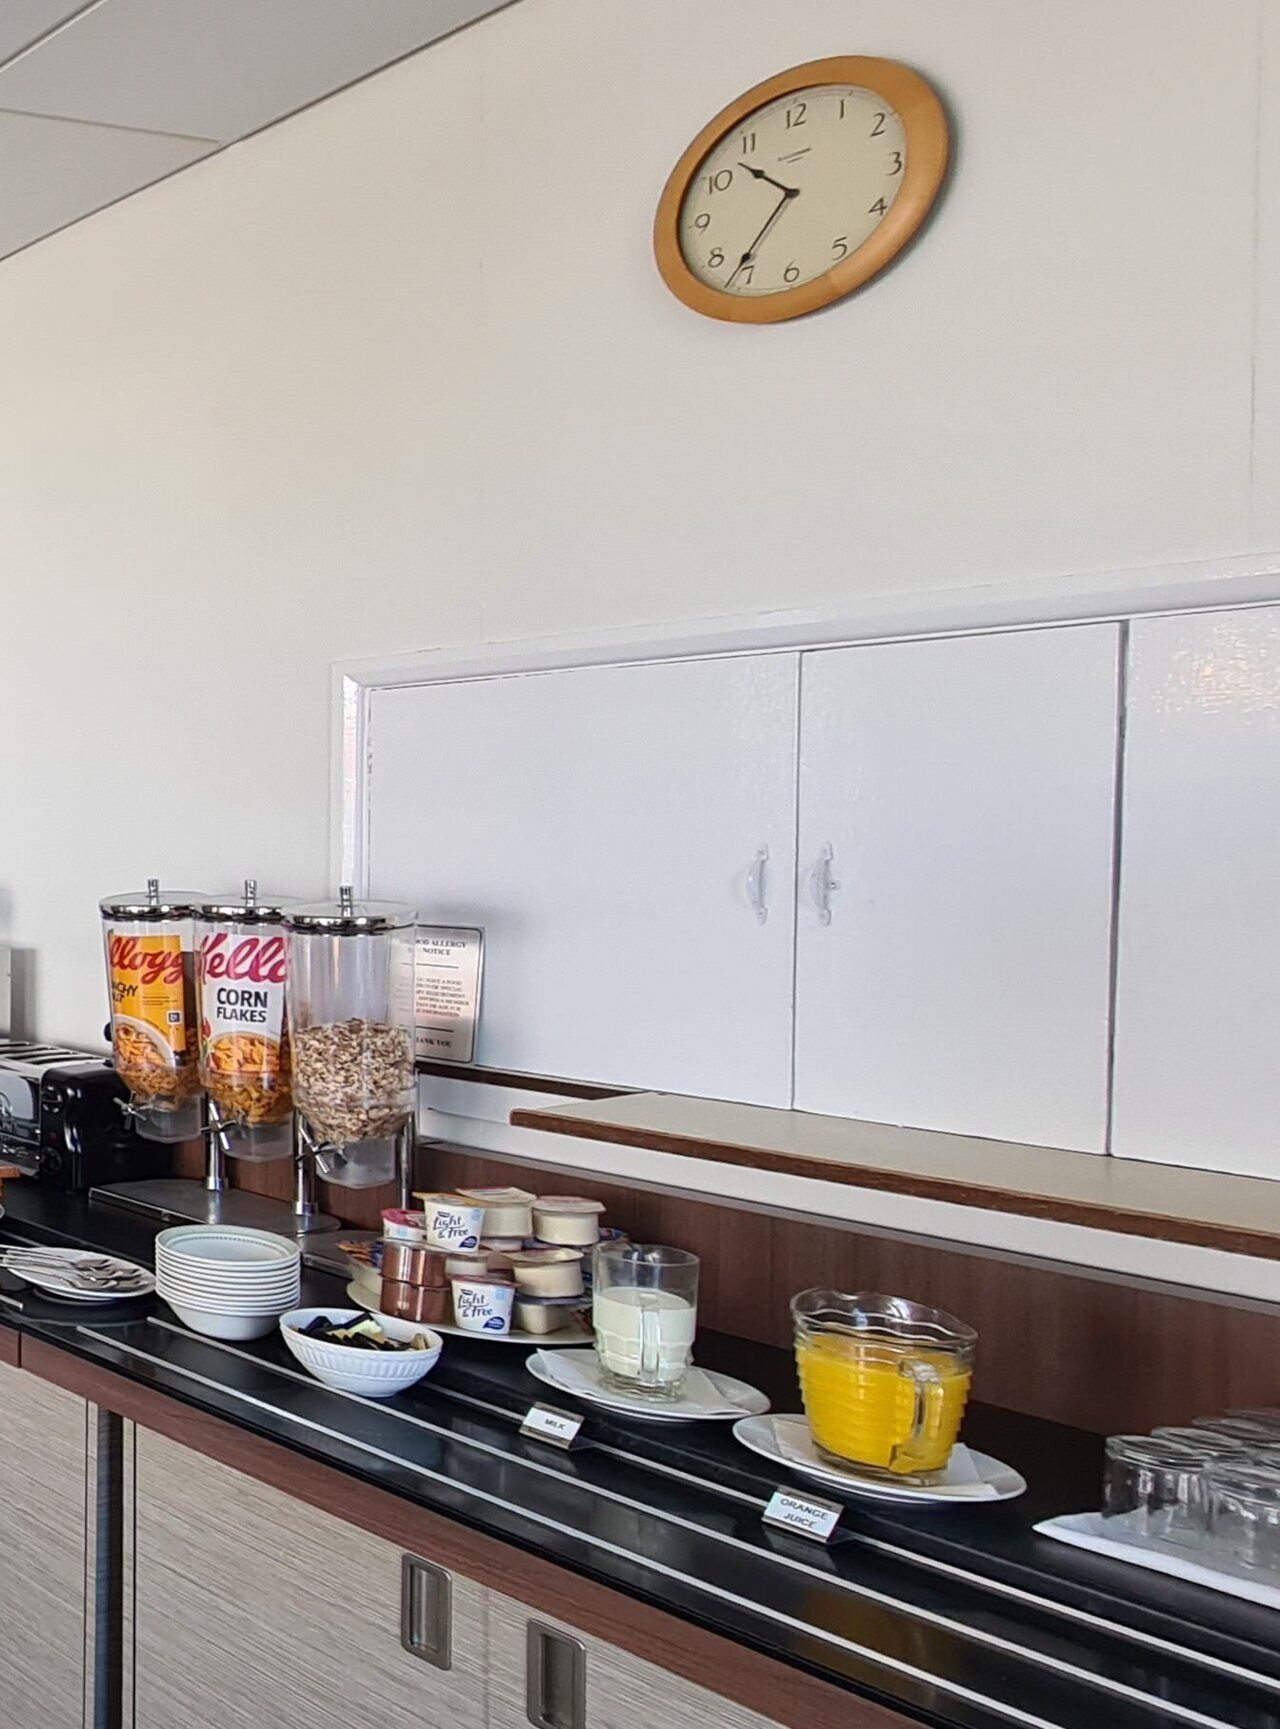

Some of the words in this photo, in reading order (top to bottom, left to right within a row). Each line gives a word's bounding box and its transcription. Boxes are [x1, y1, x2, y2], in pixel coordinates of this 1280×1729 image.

[785, 102, 807, 129] 12
[838, 98, 845, 120] 1
[869, 112, 886, 137] 2
[741, 132, 757, 155] 11
[888, 151, 903, 176] 3
[707, 169, 733, 194] 10
[868, 196, 888, 217] 4
[694, 212, 711, 235] 9
[707, 246, 725, 268] 8
[831, 236, 849, 261] 5
[740, 264, 755, 285] 7
[783, 260, 800, 284] 6
[423, 947, 450, 956] NOTICE
[216, 987, 269, 1008] CORN
[216, 1006, 268, 1023] FLAKES
[433, 1214, 465, 1230] Light
[447, 1227, 469, 1239] Free
[457, 1293, 488, 1309] Light
[471, 1305, 494, 1318] Free
[544, 1418, 566, 1431] MILK
[780, 1498, 829, 1520] ORANGE
[783, 1512, 817, 1529] JUICE
